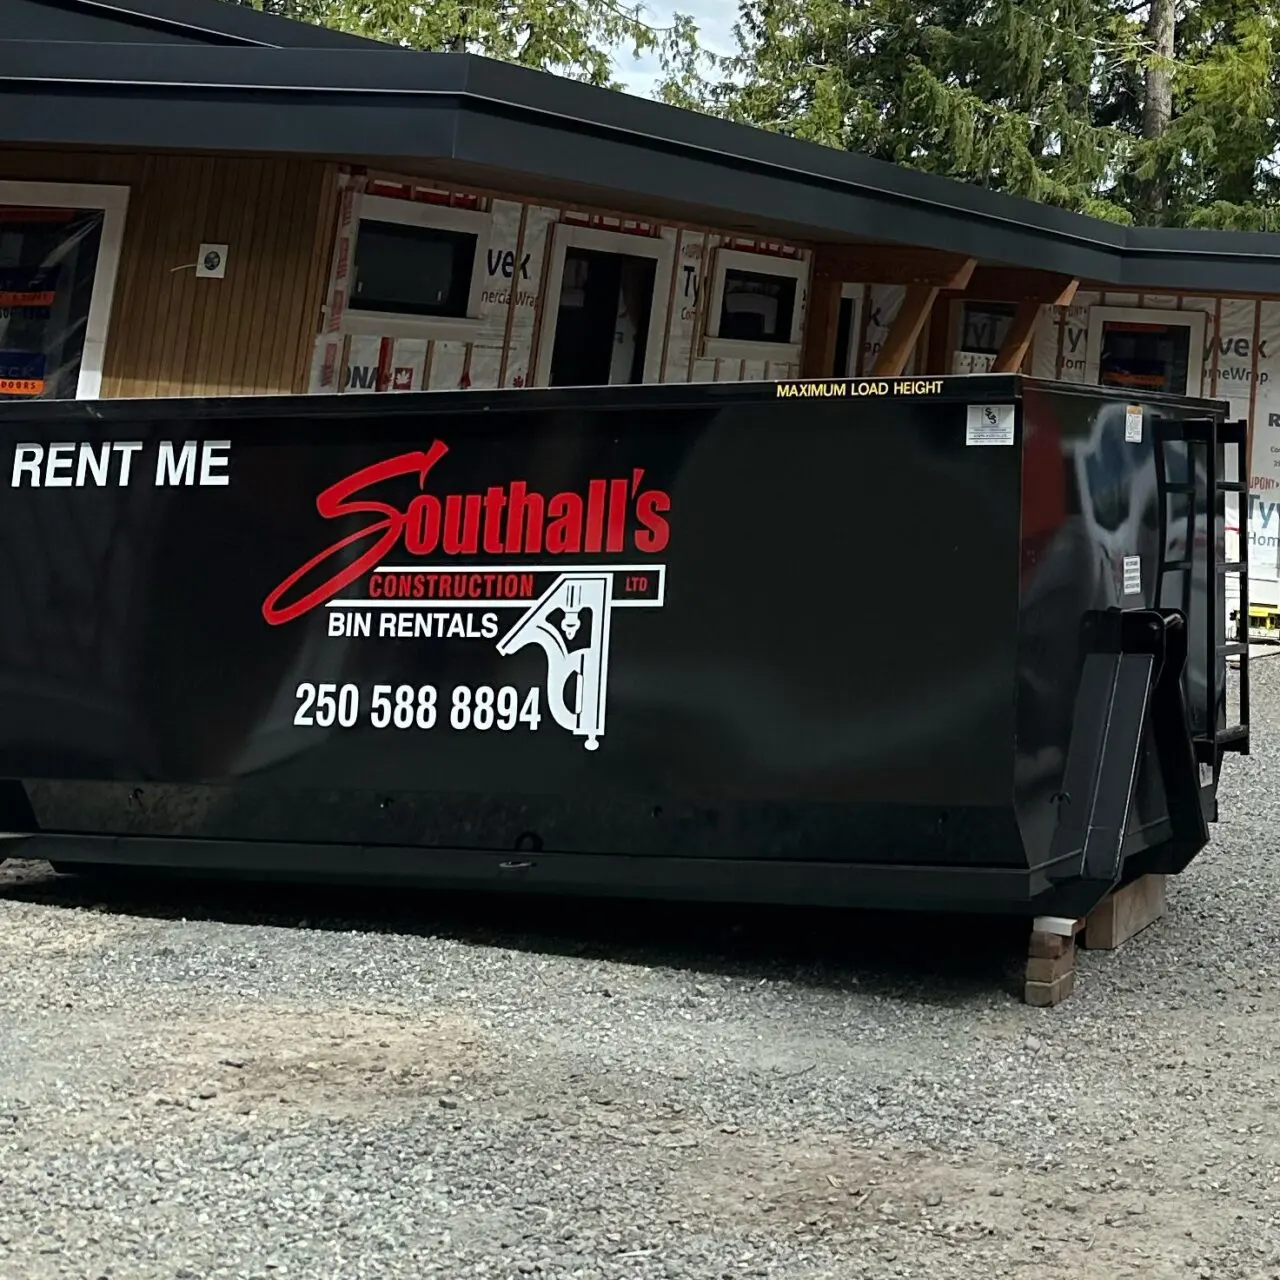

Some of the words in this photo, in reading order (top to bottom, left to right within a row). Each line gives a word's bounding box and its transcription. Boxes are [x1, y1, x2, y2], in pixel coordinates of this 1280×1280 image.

[776, 384, 846, 398] MAXIMUM
[851, 383, 889, 396] LOAD
[894, 381, 944, 394] HEIGHT
[11, 442, 142, 488] RENT
[154, 440, 231, 486] ME
[262, 439, 671, 625] Southall's
[369, 574, 533, 599] CONSTRUCTION
[625, 577, 647, 592] LTD
[328, 613, 373, 638] BIN
[379, 613, 498, 639] RENTALS
[293, 683, 359, 728] 250
[370, 685, 437, 729] 588
[450, 686, 541, 731] 8894
